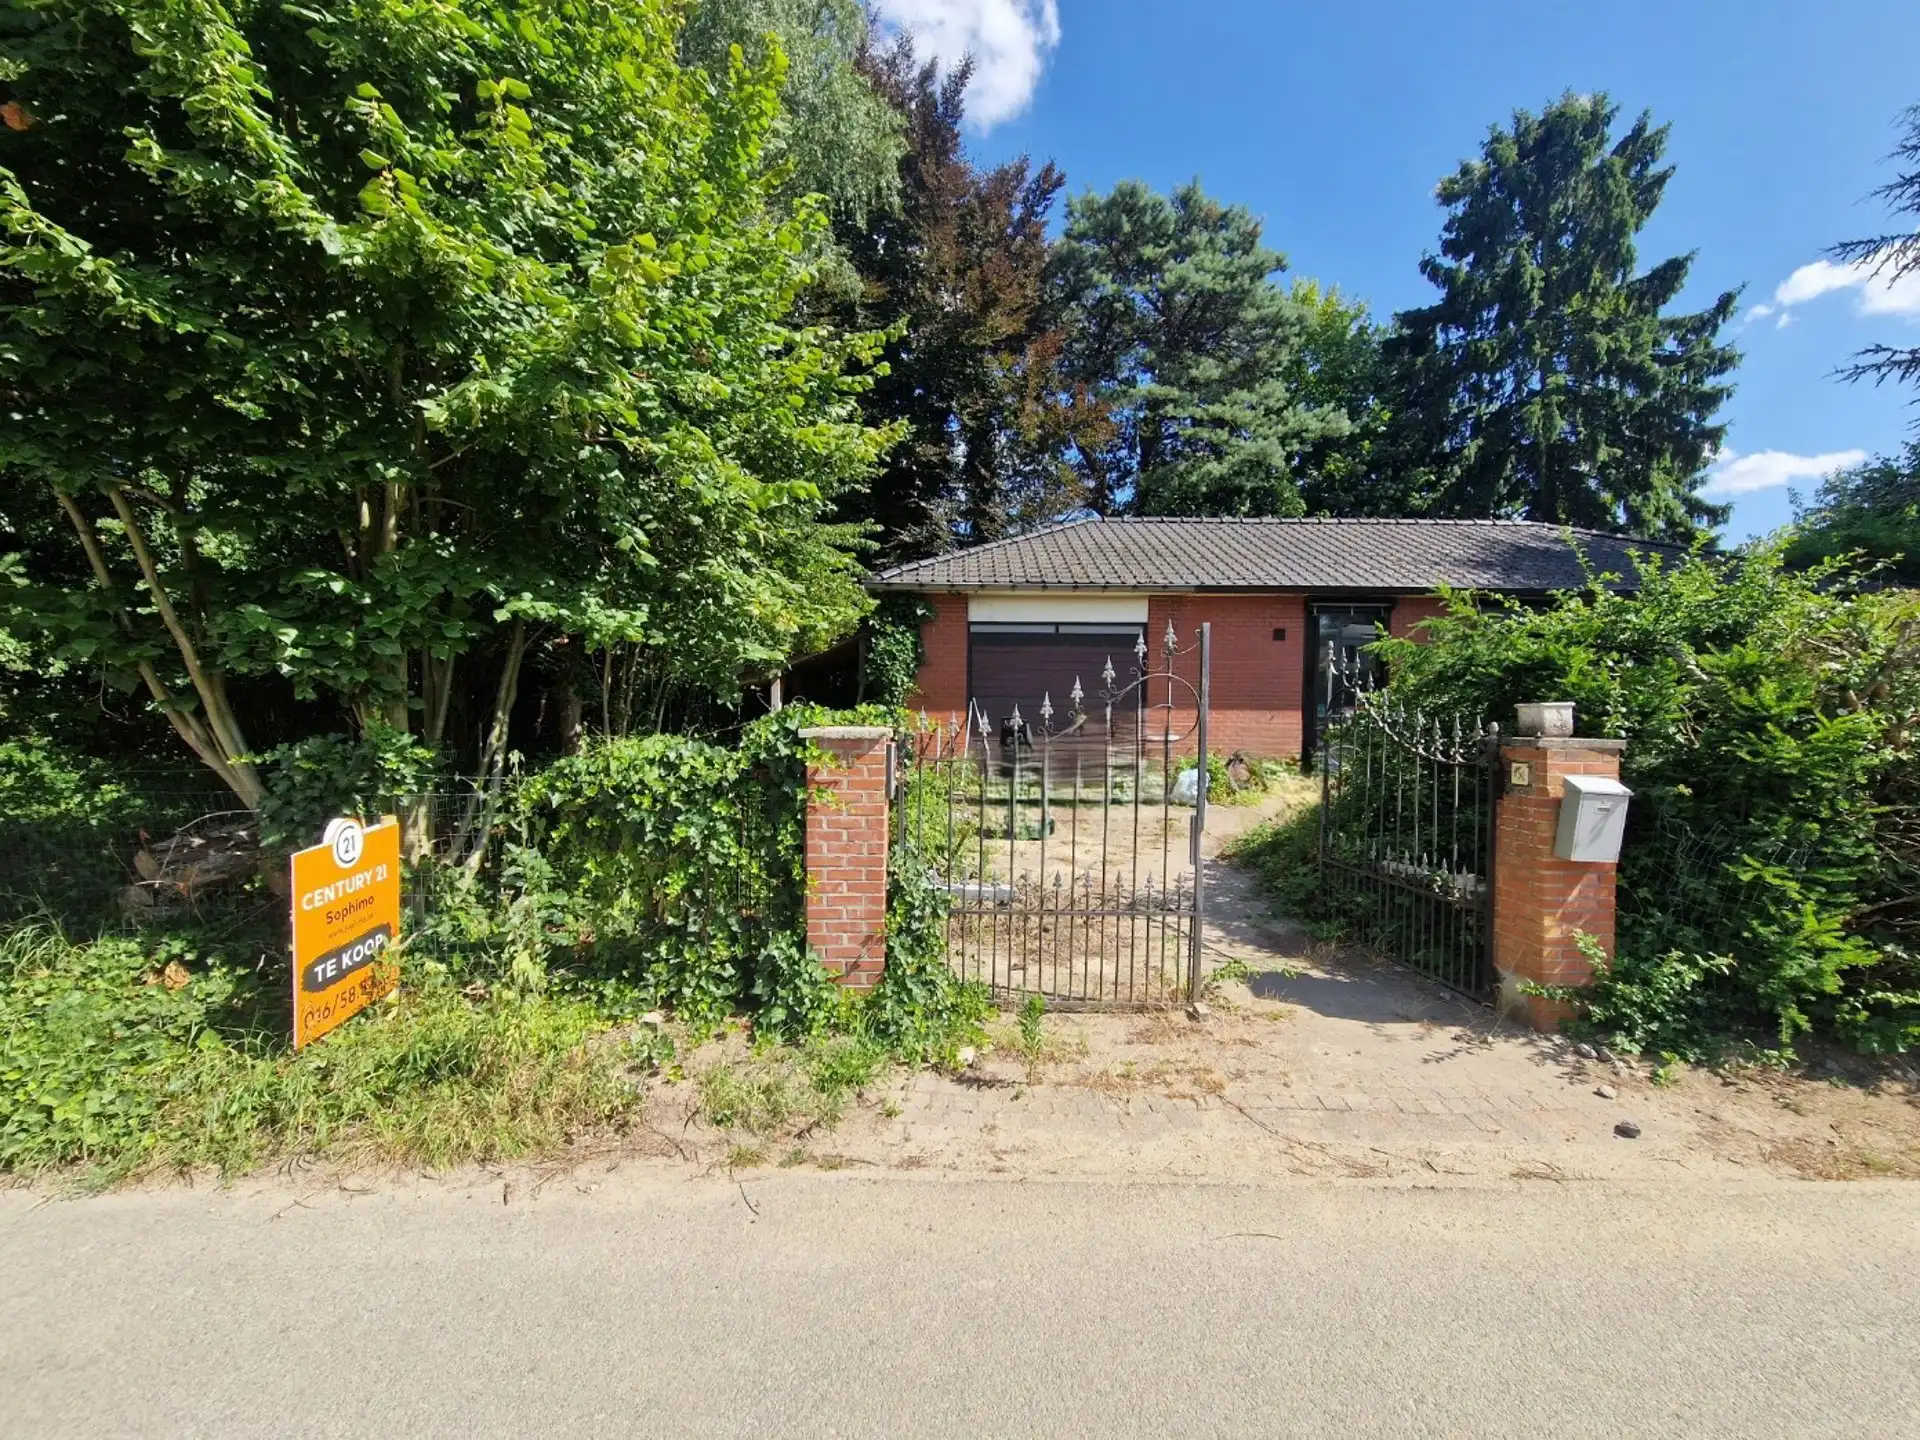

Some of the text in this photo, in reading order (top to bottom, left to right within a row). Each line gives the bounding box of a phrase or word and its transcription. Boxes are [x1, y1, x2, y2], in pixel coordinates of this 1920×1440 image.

[343, 835, 356, 855] 21
[302, 863, 388, 910] CENTURY 21
[326, 896, 374, 925] Sophimo
[314, 934, 384, 982] TE KOOP
